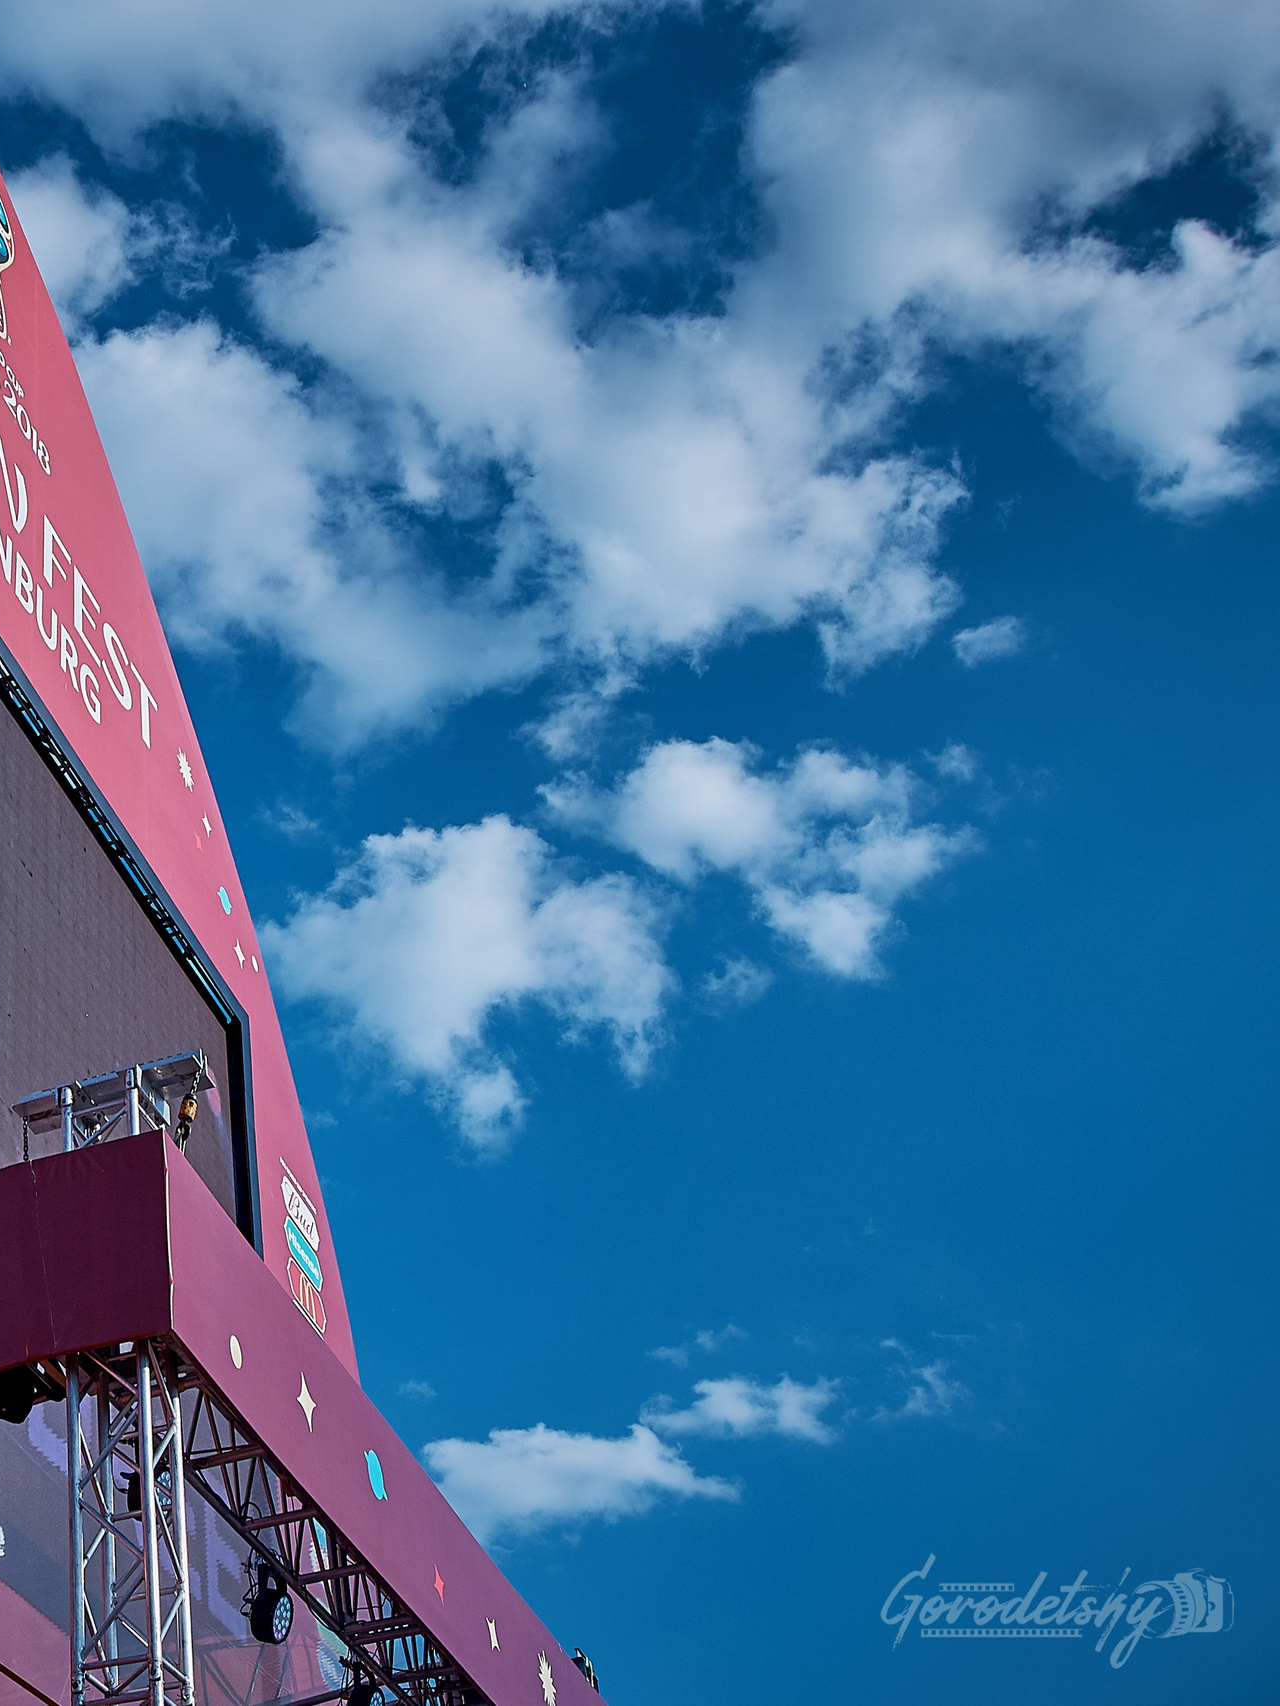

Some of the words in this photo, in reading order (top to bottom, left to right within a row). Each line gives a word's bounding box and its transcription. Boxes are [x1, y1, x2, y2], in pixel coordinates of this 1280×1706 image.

[6, 364, 25, 399] CUP
[3, 379, 51, 476] 2018
[43, 514, 159, 749] FEST
[284, 1181, 315, 1241] Bud
[287, 1227, 320, 1280] Hisense
